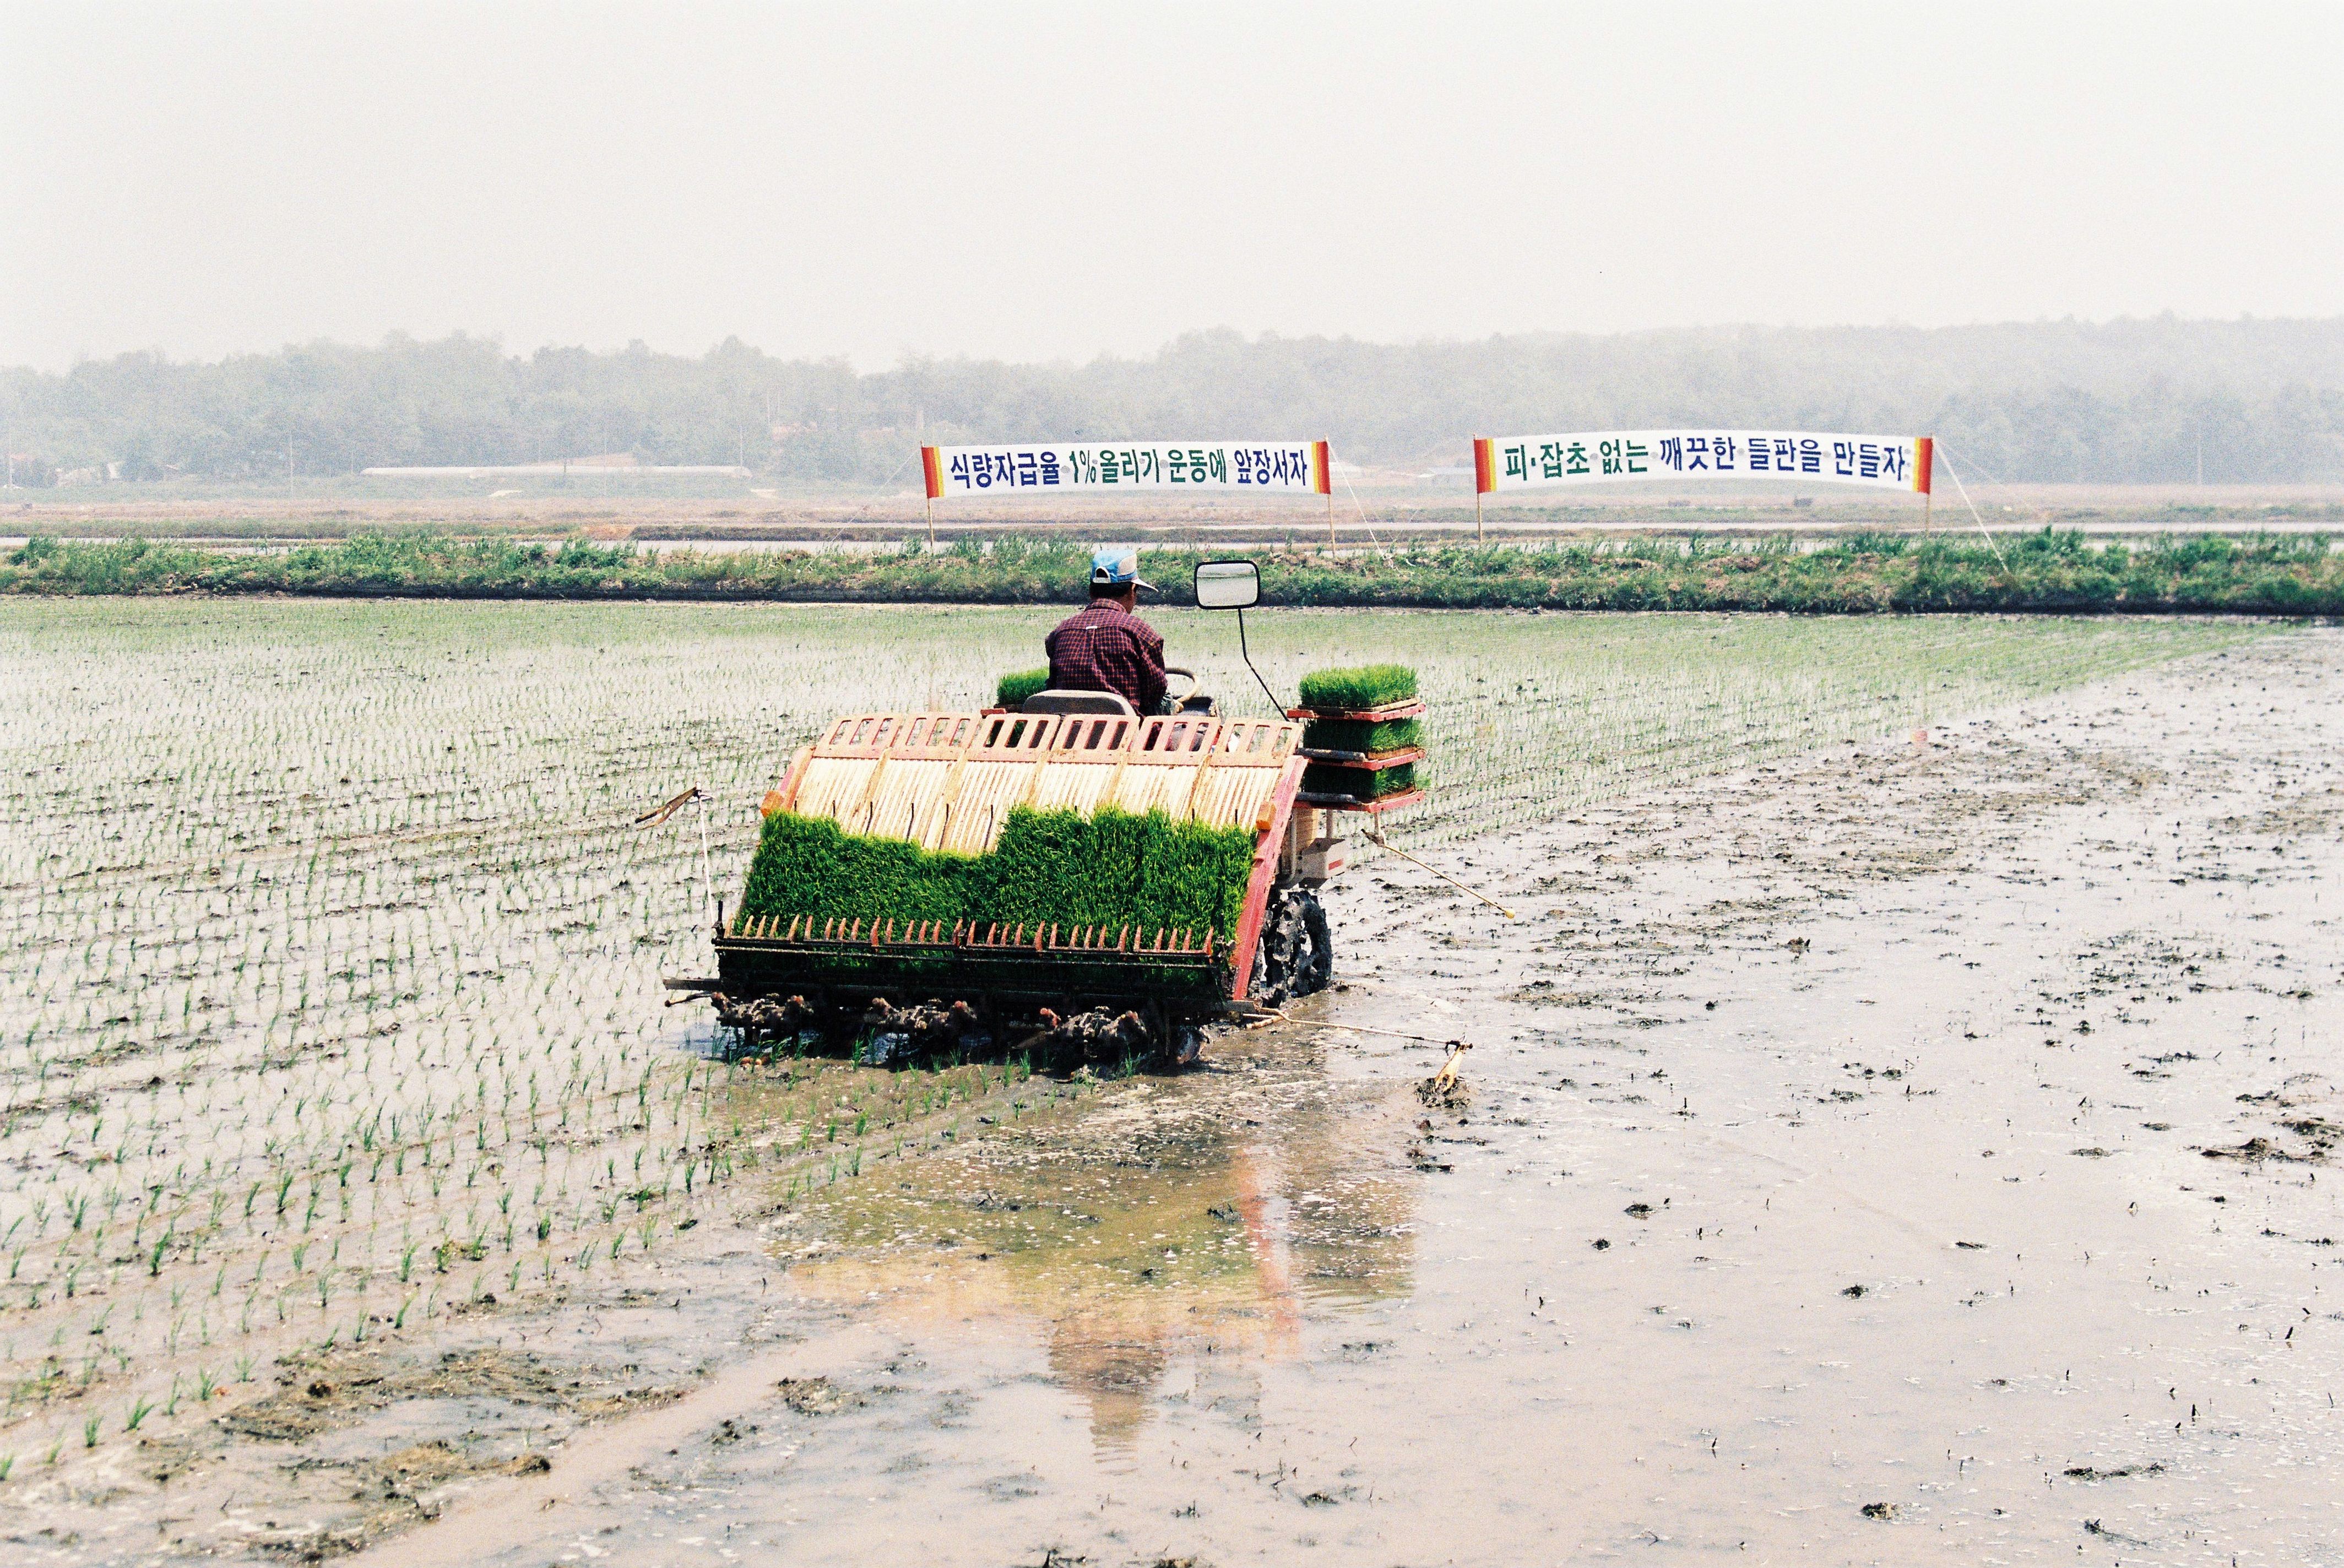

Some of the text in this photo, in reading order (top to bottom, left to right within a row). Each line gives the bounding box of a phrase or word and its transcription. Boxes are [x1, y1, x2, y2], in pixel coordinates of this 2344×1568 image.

[950, 451, 1060, 489] 식량자급율
[1168, 449, 1227, 484] 운동에
[1234, 449, 1307, 486] 앞장서자
[1599, 439, 1649, 475] 없는
[1660, 437, 1736, 471] 깨끗한
[1748, 438, 1822, 473] 들판을
[1833, 442, 1906, 481] 만들자
